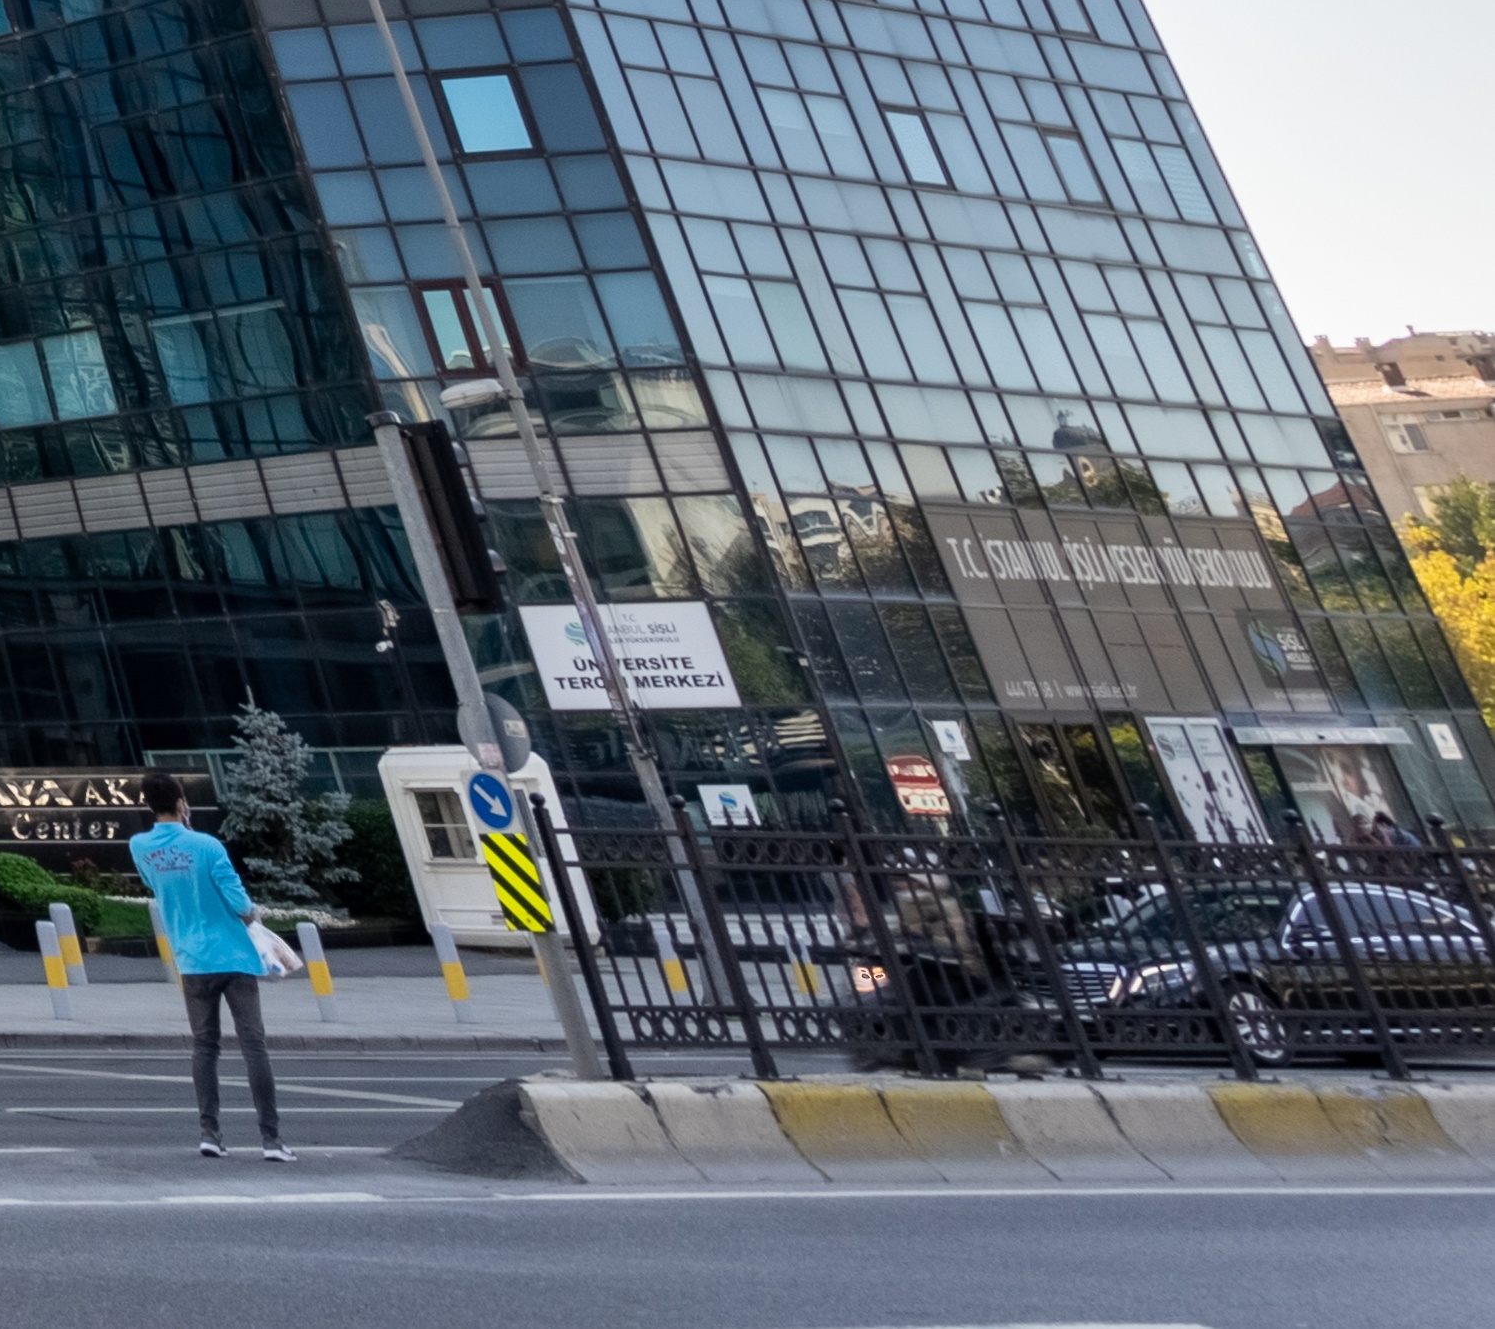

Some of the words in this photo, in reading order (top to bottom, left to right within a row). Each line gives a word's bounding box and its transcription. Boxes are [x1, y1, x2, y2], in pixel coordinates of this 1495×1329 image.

[946, 538, 988, 579] T.C.
[607, 624, 646, 635] ANBUL
[647, 621, 677, 635] ŞİŞLİ
[572, 654, 694, 672] ÜNERSİTE
[554, 674, 628, 690] TERC
[634, 671, 725, 688] MERKEZİ
[12, 812, 120, 840] Center
